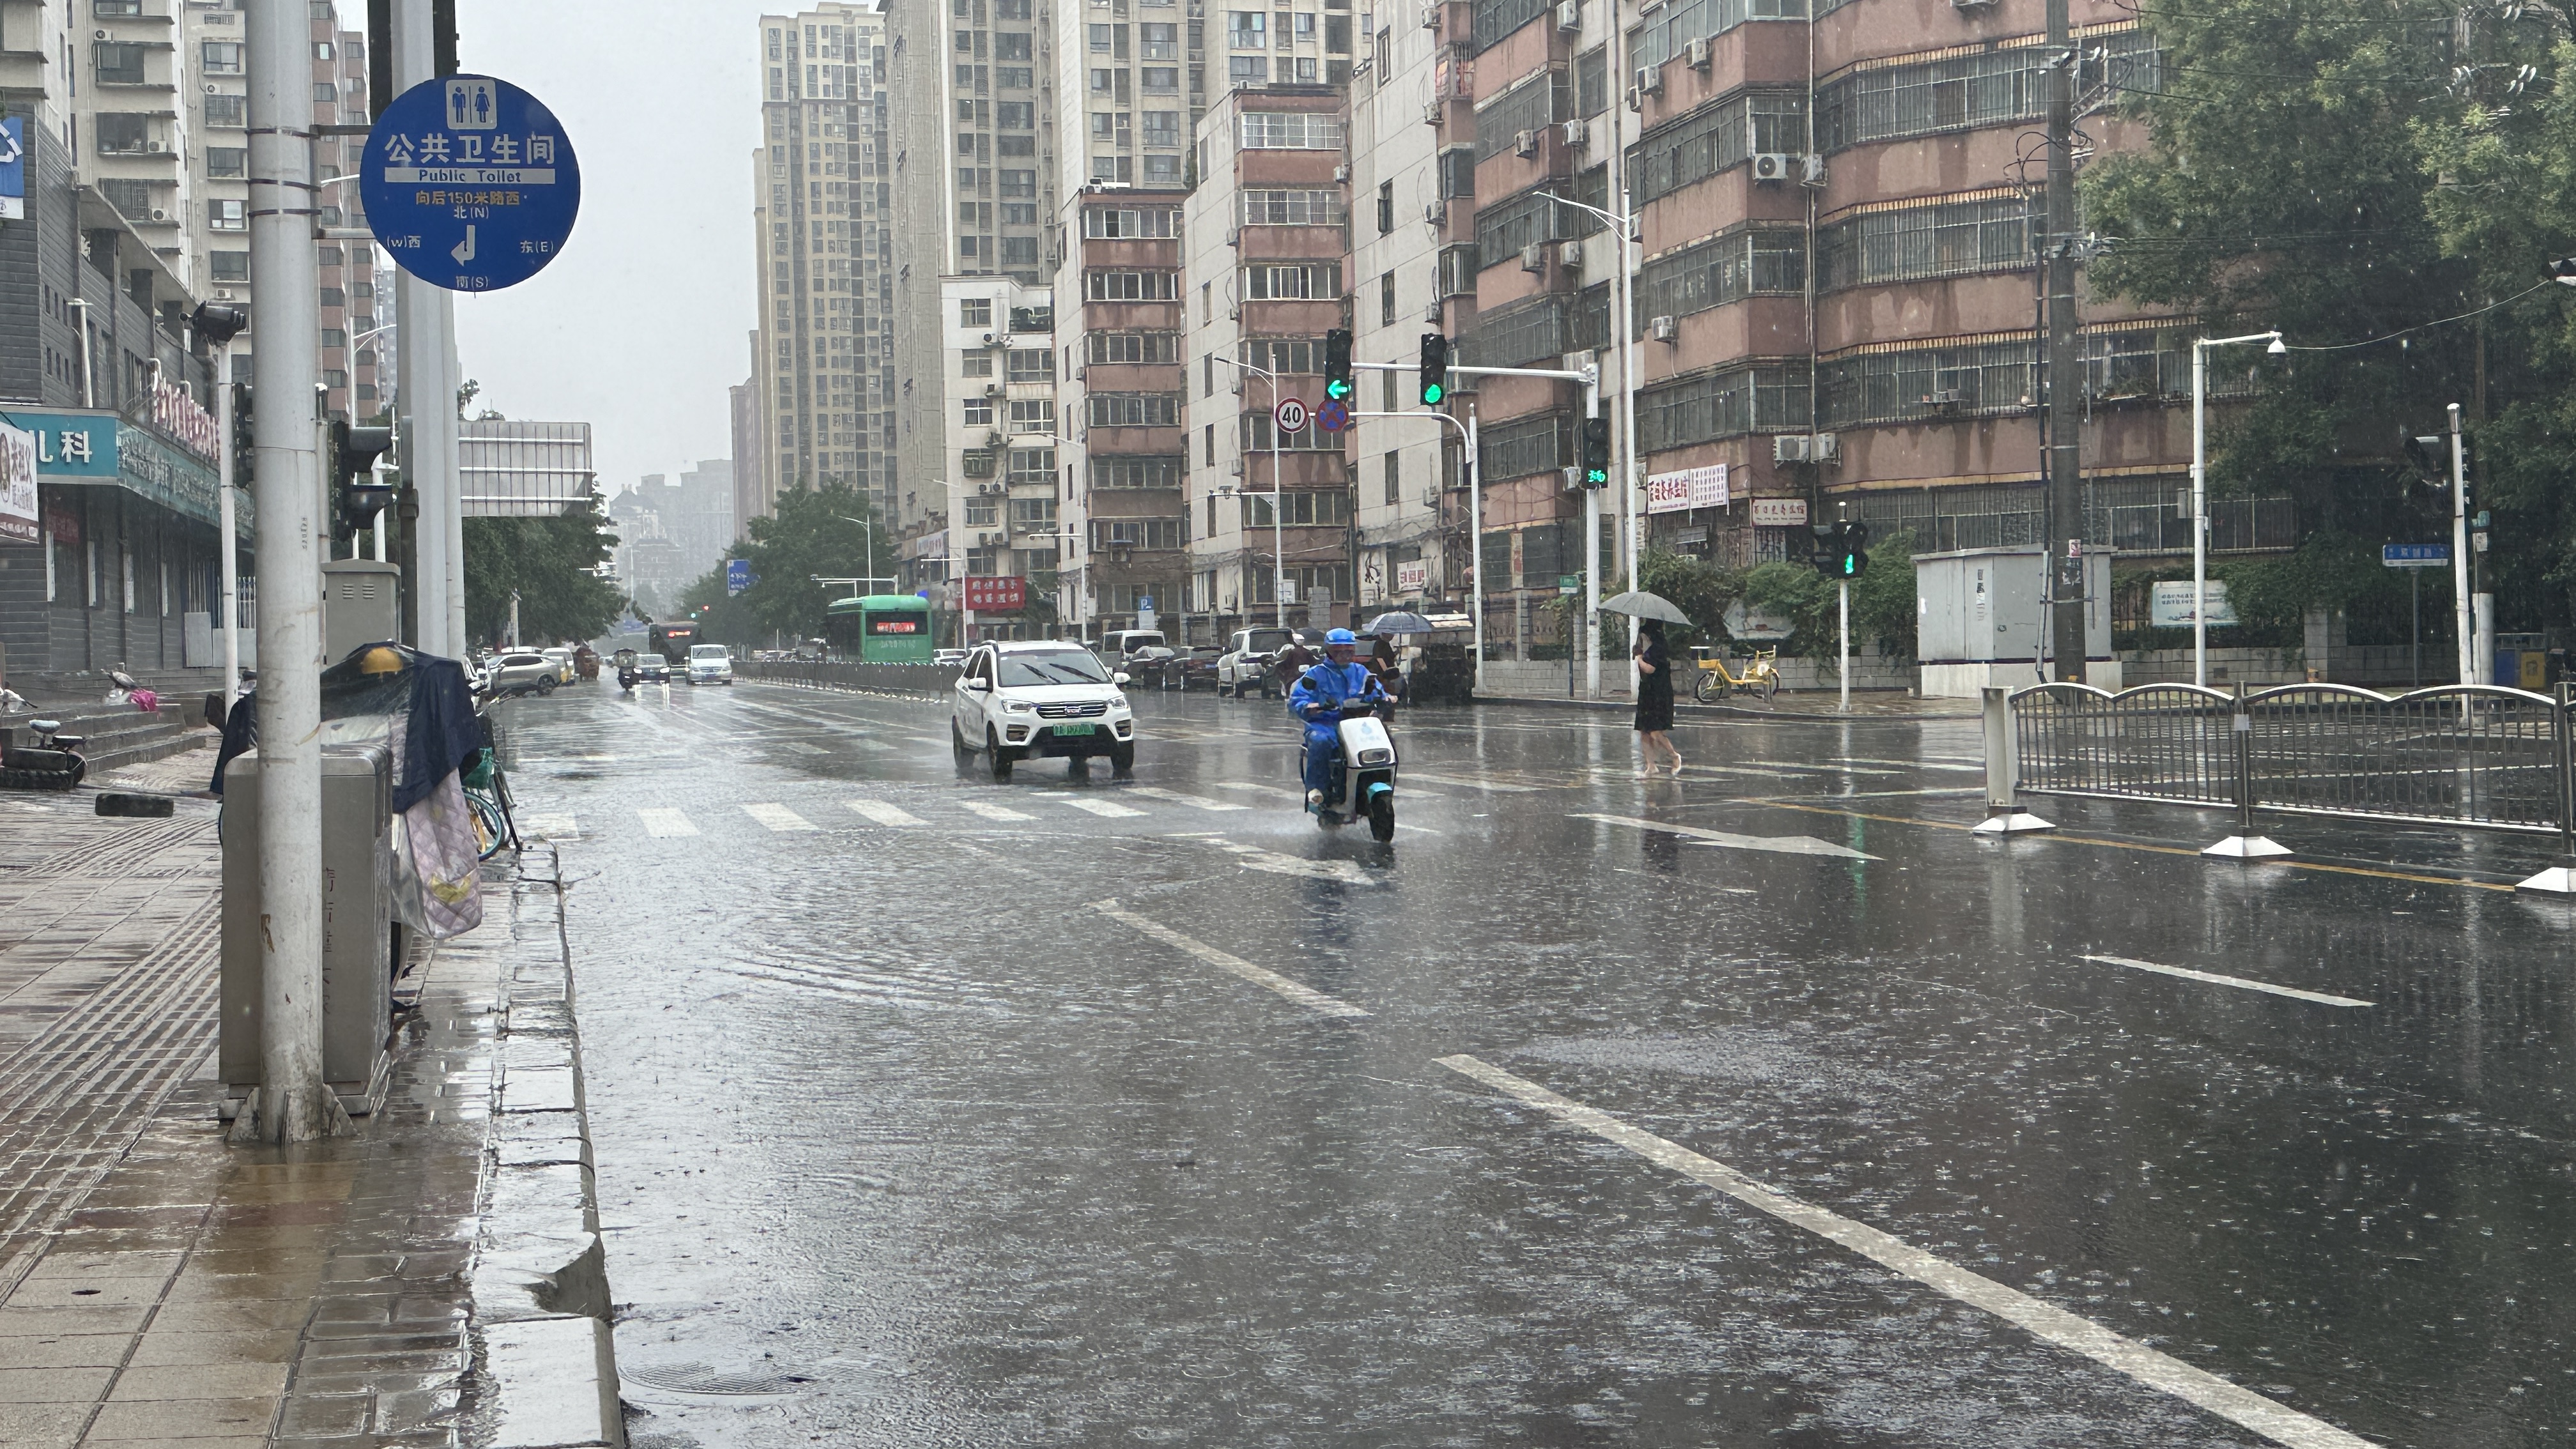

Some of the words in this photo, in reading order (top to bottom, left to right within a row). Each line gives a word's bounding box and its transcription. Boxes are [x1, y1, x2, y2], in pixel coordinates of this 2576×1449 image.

[385, 132, 555, 164] 公共卫生间
[418, 169, 466, 182] Public
[416, 190, 520, 206] 向后150米路西
[454, 206, 489, 219] 北(N)
[520, 240, 554, 253] 东(E)
[456, 275, 489, 289] 南(S)
[1282, 406, 1301, 423] 40
[1140, 599, 1147, 610] P
